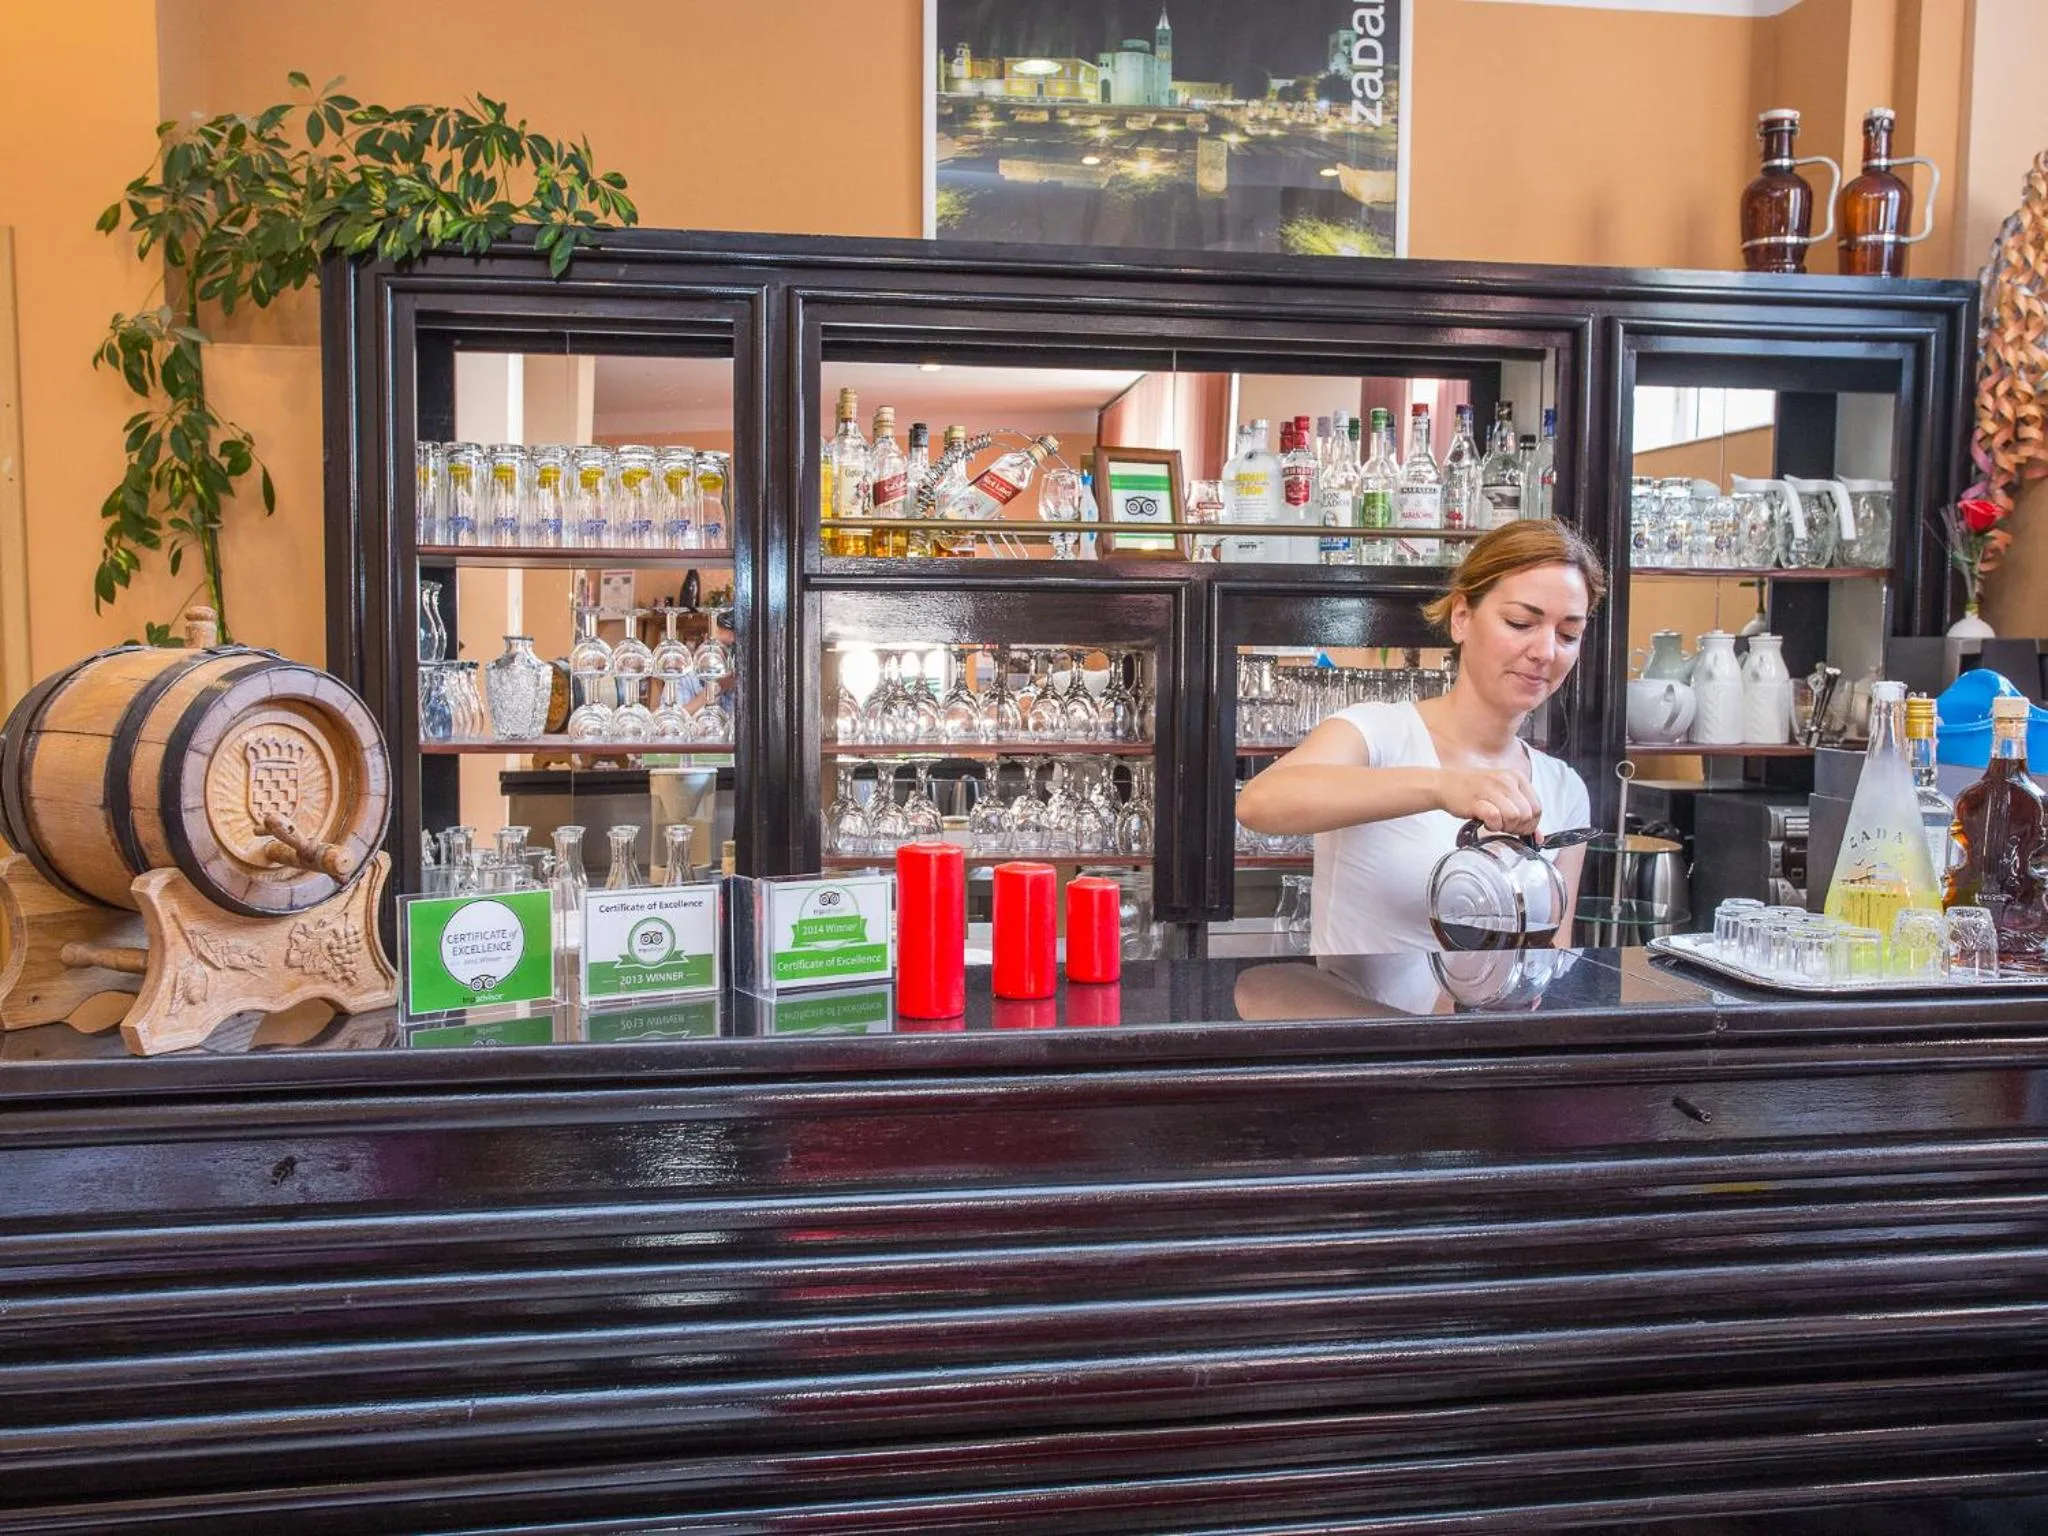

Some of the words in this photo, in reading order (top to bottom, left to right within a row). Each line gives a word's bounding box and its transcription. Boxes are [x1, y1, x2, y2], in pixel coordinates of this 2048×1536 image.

[1351, 0, 1385, 128] zaDa
[599, 903, 644, 913] Certificate
[647, 902, 657, 910] of
[659, 900, 703, 909] Excellence
[447, 929, 508, 944] CERTIFICATE
[802, 926, 824, 935] 2014
[825, 923, 856, 933] Winner
[452, 942, 512, 957] EXCELLENCE
[777, 959, 824, 971] Certificate
[826, 957, 836, 967] of
[836, 955, 881, 967] Excellence
[620, 974, 643, 985] 2013
[645, 972, 684, 983] WINNER
